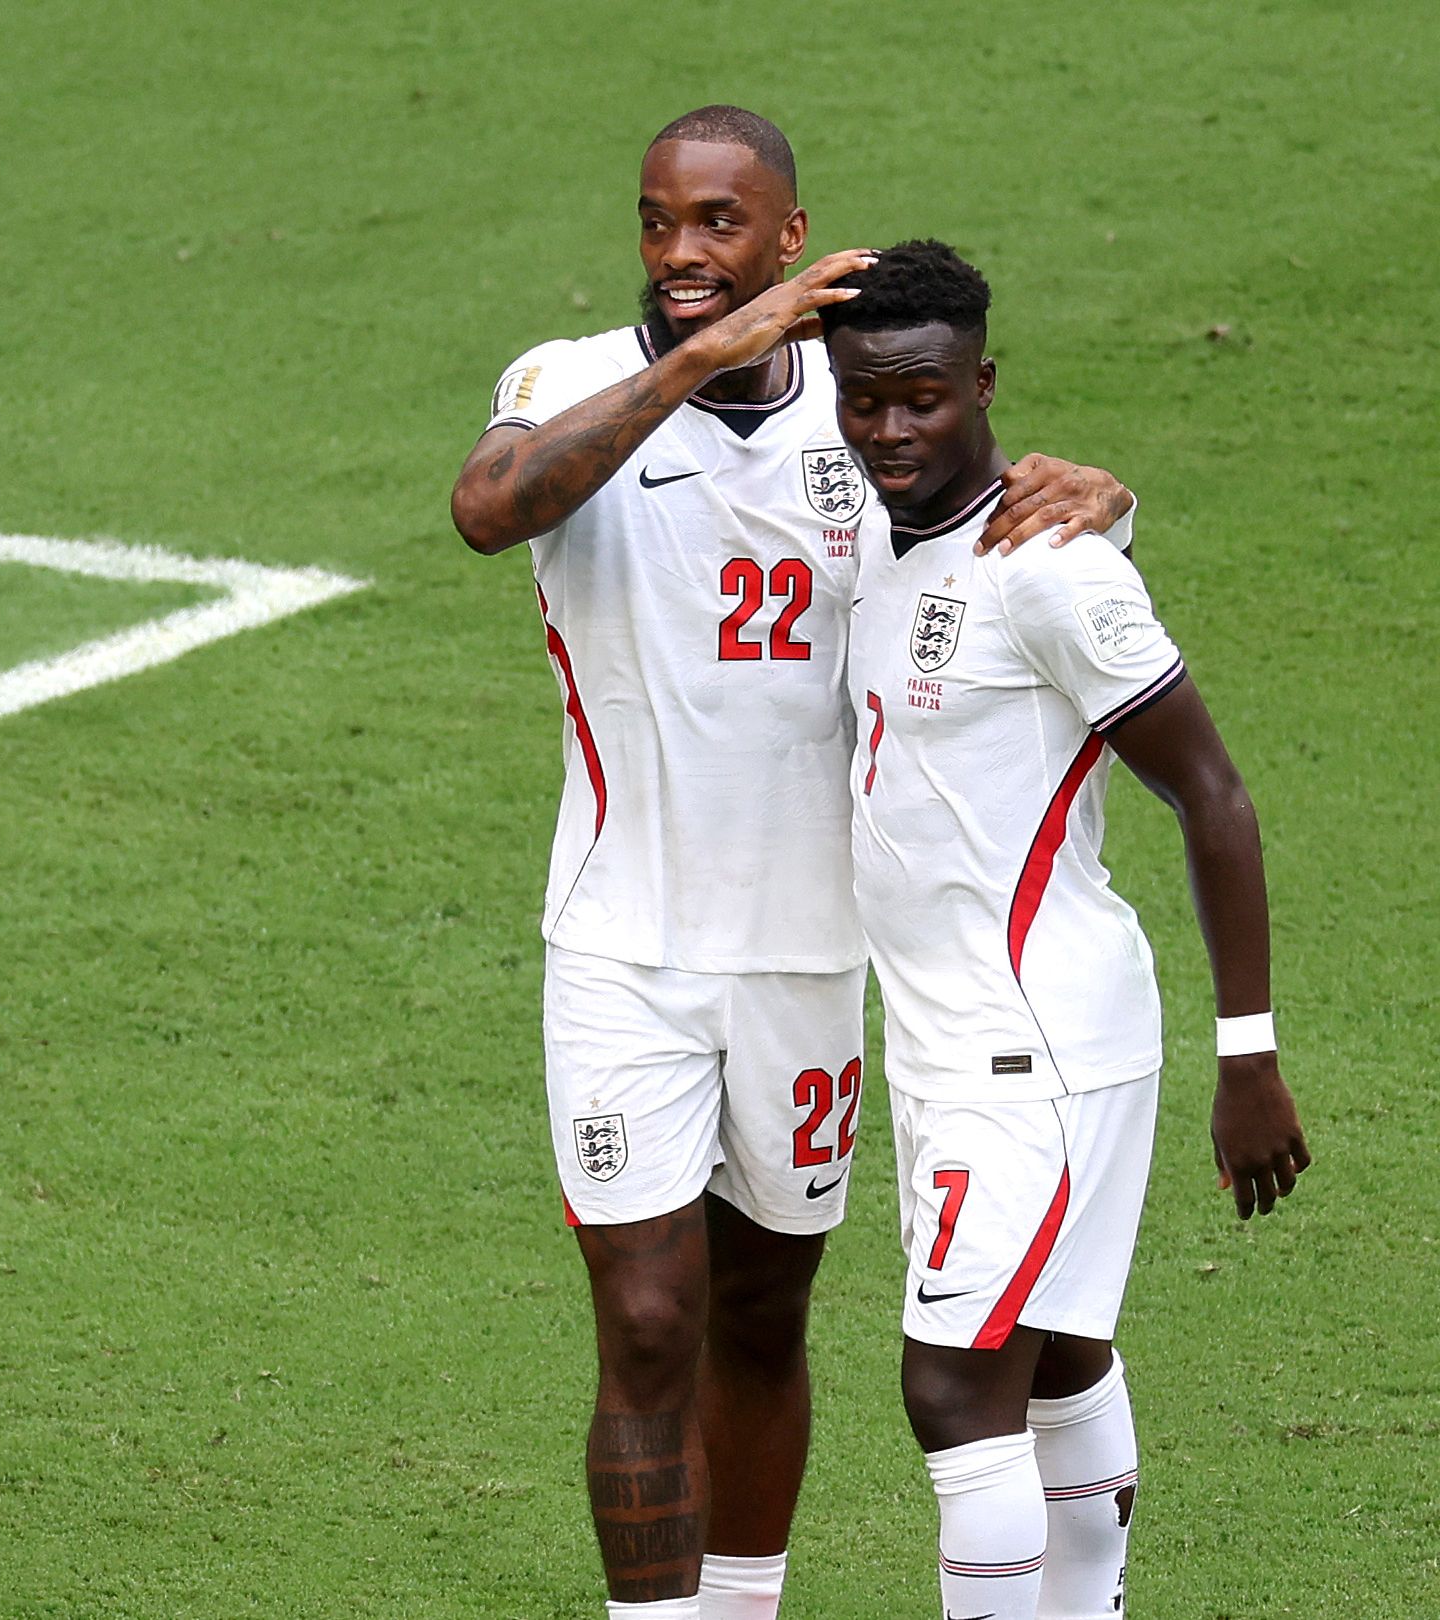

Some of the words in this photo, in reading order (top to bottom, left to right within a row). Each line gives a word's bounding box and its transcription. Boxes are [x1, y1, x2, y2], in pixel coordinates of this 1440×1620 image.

[822, 529, 857, 542] FRANC
[718, 558, 813, 661] 22
[1092, 603, 1128, 631] UNITES
[907, 678, 943, 696] FRANCE
[863, 689, 885, 797] 7
[792, 1056, 862, 1168] 22
[927, 1170, 970, 1272] 7
